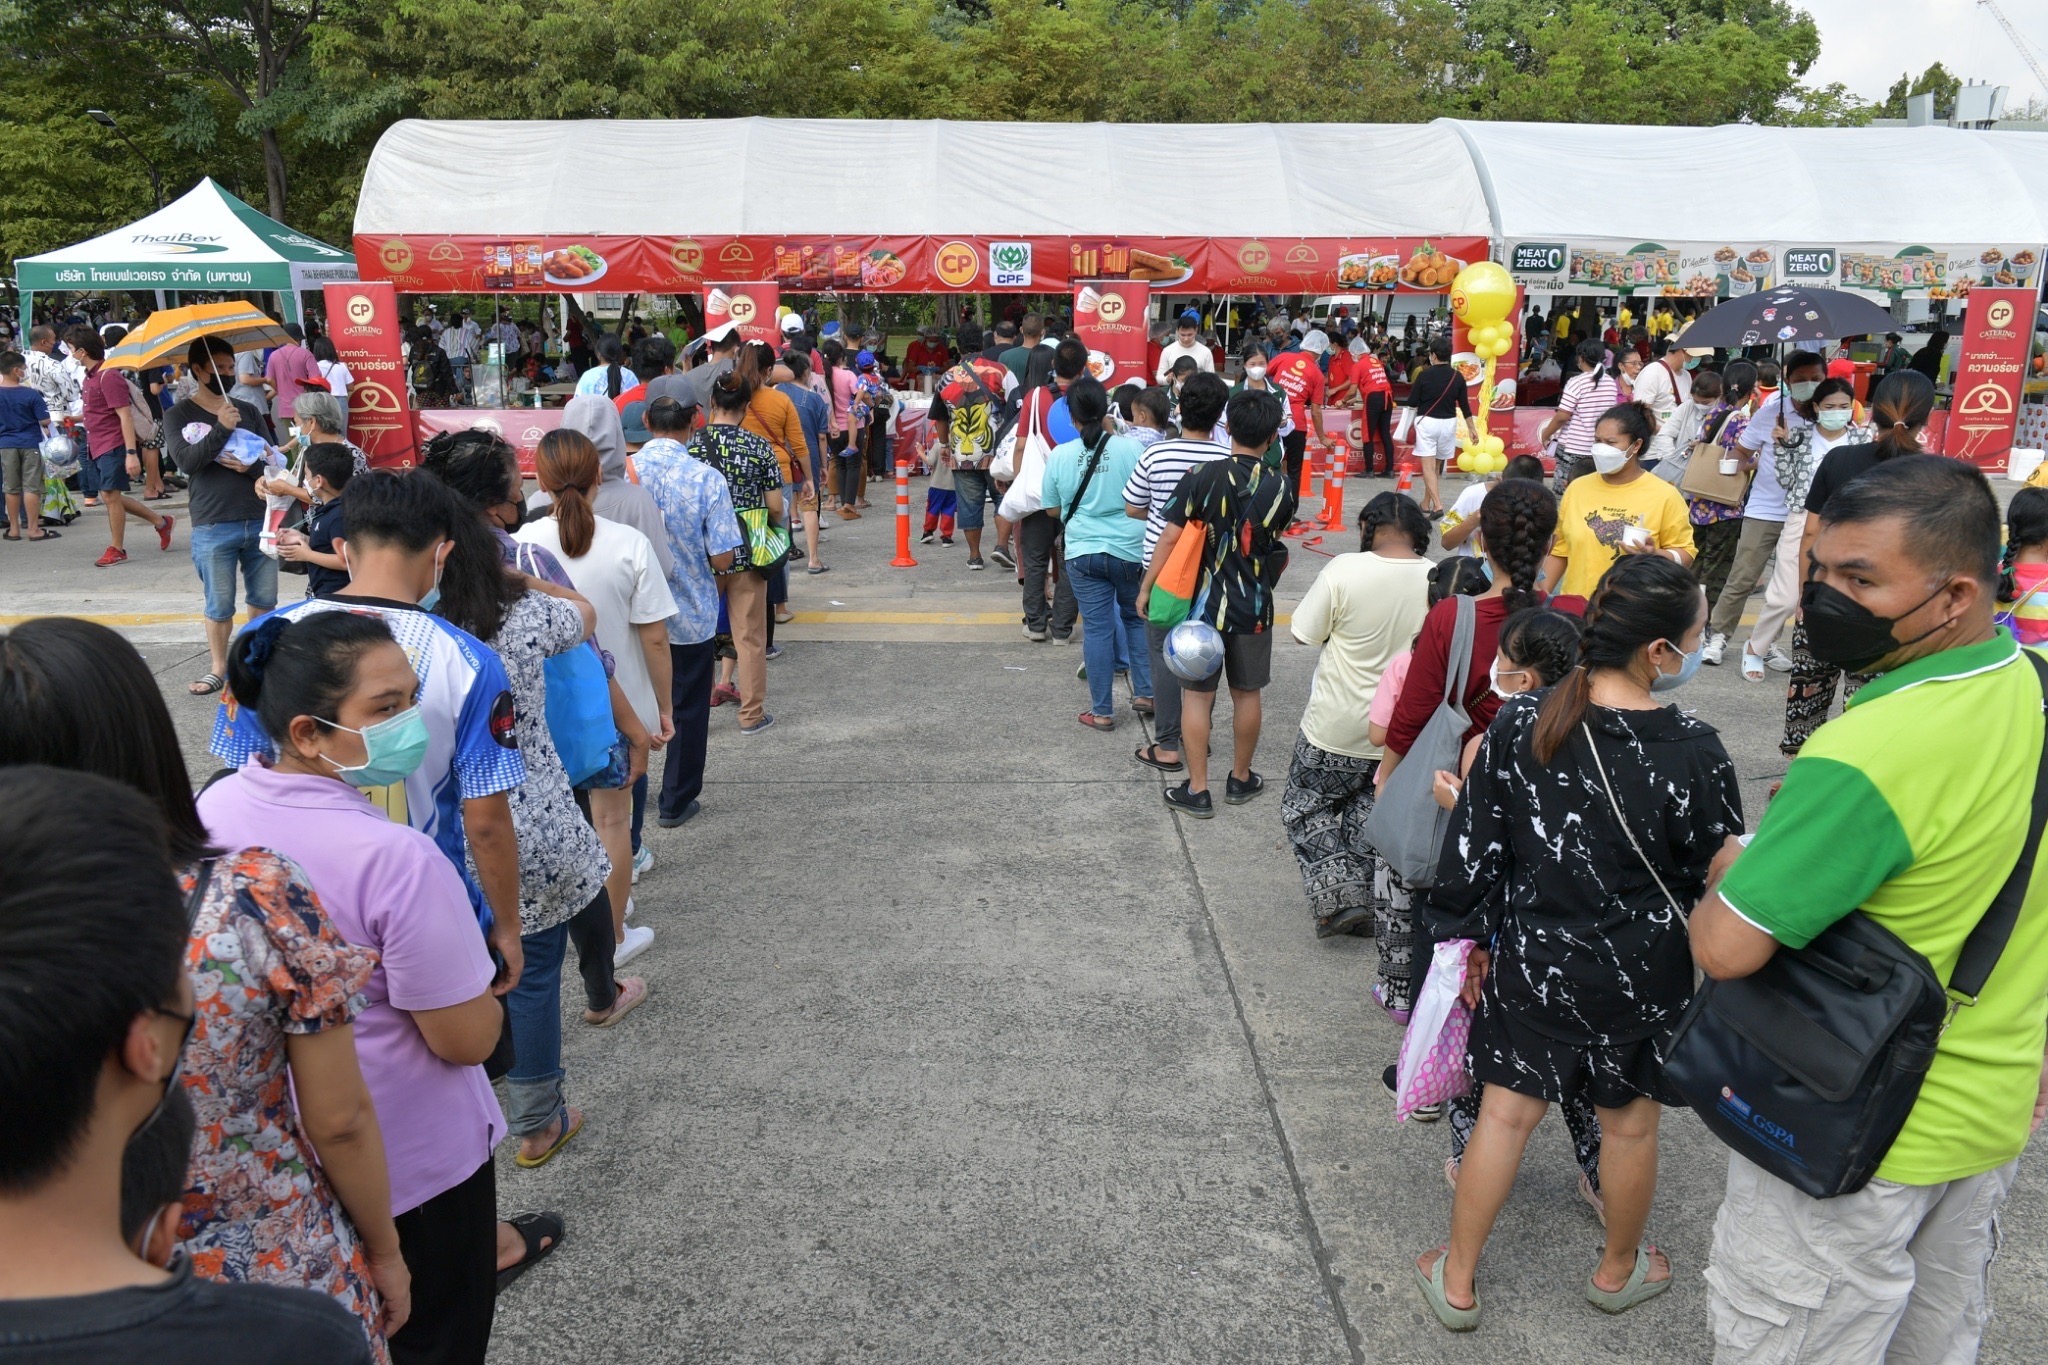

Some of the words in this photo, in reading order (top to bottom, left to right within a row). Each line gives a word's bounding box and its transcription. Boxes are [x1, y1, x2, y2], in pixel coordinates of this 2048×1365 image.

[131, 233, 222, 243] ThaiBev
[384, 249, 408, 263] CP
[675, 249, 699, 263] CP
[1242, 250, 1266, 265] CP
[1517, 249, 1547, 258] MEAT
[1789, 253, 1817, 262] MEAT
[941, 255, 972, 273] CP
[1516, 259, 1547, 268] ZERO
[1789, 263, 1818, 272] ZERO
[56, 270, 85, 282] บริษัท
[171, 269, 201, 282] จำกัด
[206, 270, 252, 284] (มหาชน)
[997, 274, 1024, 284] CPF
[1229, 276, 1277, 287] CATERING
[1101, 302, 1121, 314] CP
[1452, 297, 1465, 309] CP
[350, 304, 370, 316] CP
[732, 303, 752, 316] CP
[1990, 308, 2010, 320] CP
[343, 325, 382, 335] CATERING
[1091, 323, 1131, 333] CATERING
[1979, 329, 2016, 339] CATERING
[1753, 1114, 1795, 1148] GSPA
